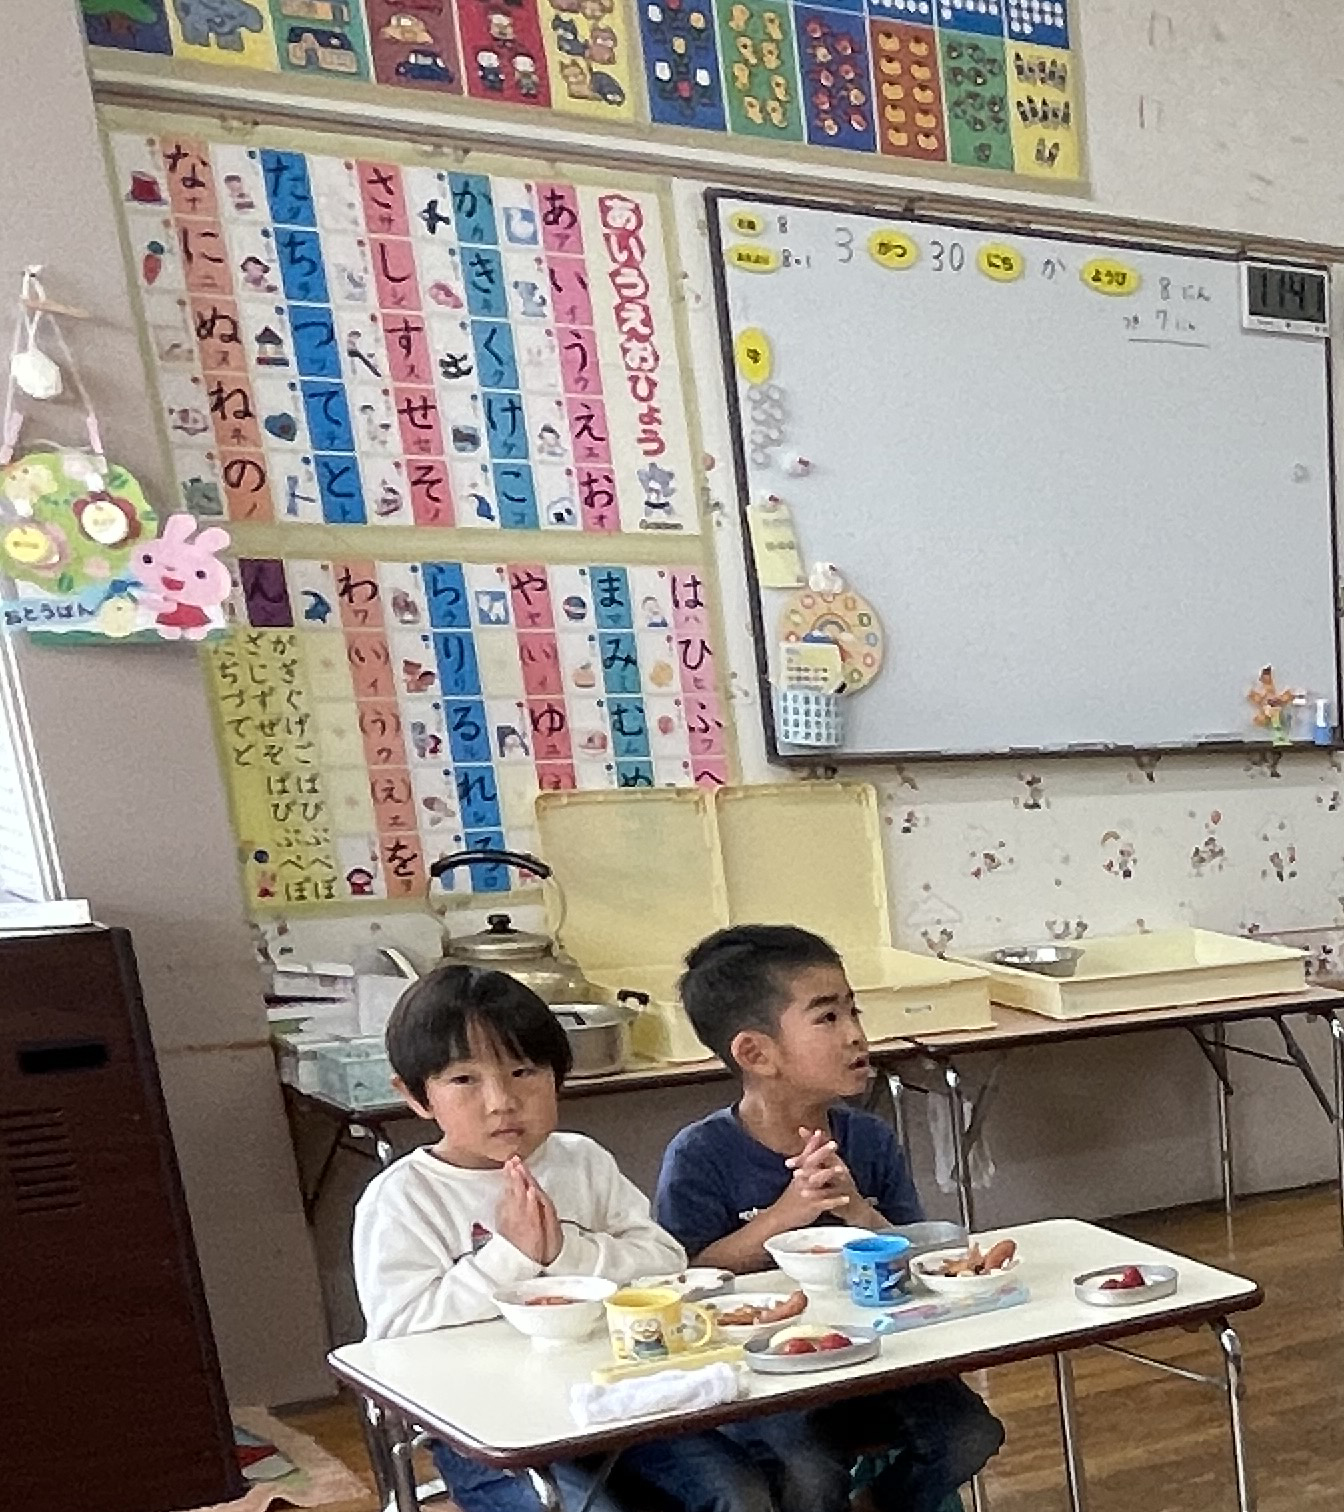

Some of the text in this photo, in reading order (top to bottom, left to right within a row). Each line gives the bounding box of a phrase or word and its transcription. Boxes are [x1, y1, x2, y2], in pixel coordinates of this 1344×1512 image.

[163, 144, 209, 189] な
[265, 154, 309, 200] た
[366, 166, 395, 210] さ
[452, 180, 494, 219] か
[542, 187, 578, 230] あ
[182, 227, 225, 264] に
[283, 232, 318, 278] ち
[378, 242, 412, 284] し
[835, 226, 854, 264] 3
[929, 239, 965, 273] 30
[986, 253, 1015, 273] にち
[1091, 268, 1128, 287] ようび
[468, 252, 496, 294] き
[548, 267, 588, 294] い
[195, 306, 242, 345] ぬ
[293, 321, 334, 348] つ
[384, 316, 424, 358] す
[597, 193, 666, 458] あいうえおひょう
[483, 326, 504, 366] く
[562, 329, 588, 373] う
[208, 380, 254, 421] ね
[308, 390, 342, 426] て
[397, 394, 437, 430] せ
[486, 398, 523, 438] け
[572, 401, 607, 442] え
[223, 457, 267, 493] の
[321, 460, 356, 499] と
[410, 464, 443, 504] そ
[500, 469, 528, 504] こ
[579, 471, 615, 510] お
[431, 565, 460, 606] ら
[597, 570, 624, 608] ま
[670, 574, 704, 610] は
[442, 636, 466, 675] り
[510, 569, 548, 606] や
[529, 702, 566, 738] ゆ
[604, 639, 637, 671] み
[677, 638, 713, 671] ひ
[338, 567, 379, 604] わ
[384, 837, 418, 878] を
[452, 705, 482, 742] る
[611, 703, 644, 736] む
[688, 702, 723, 735] ふ
[457, 771, 498, 807] れ
[695, 770, 725, 786] へ
